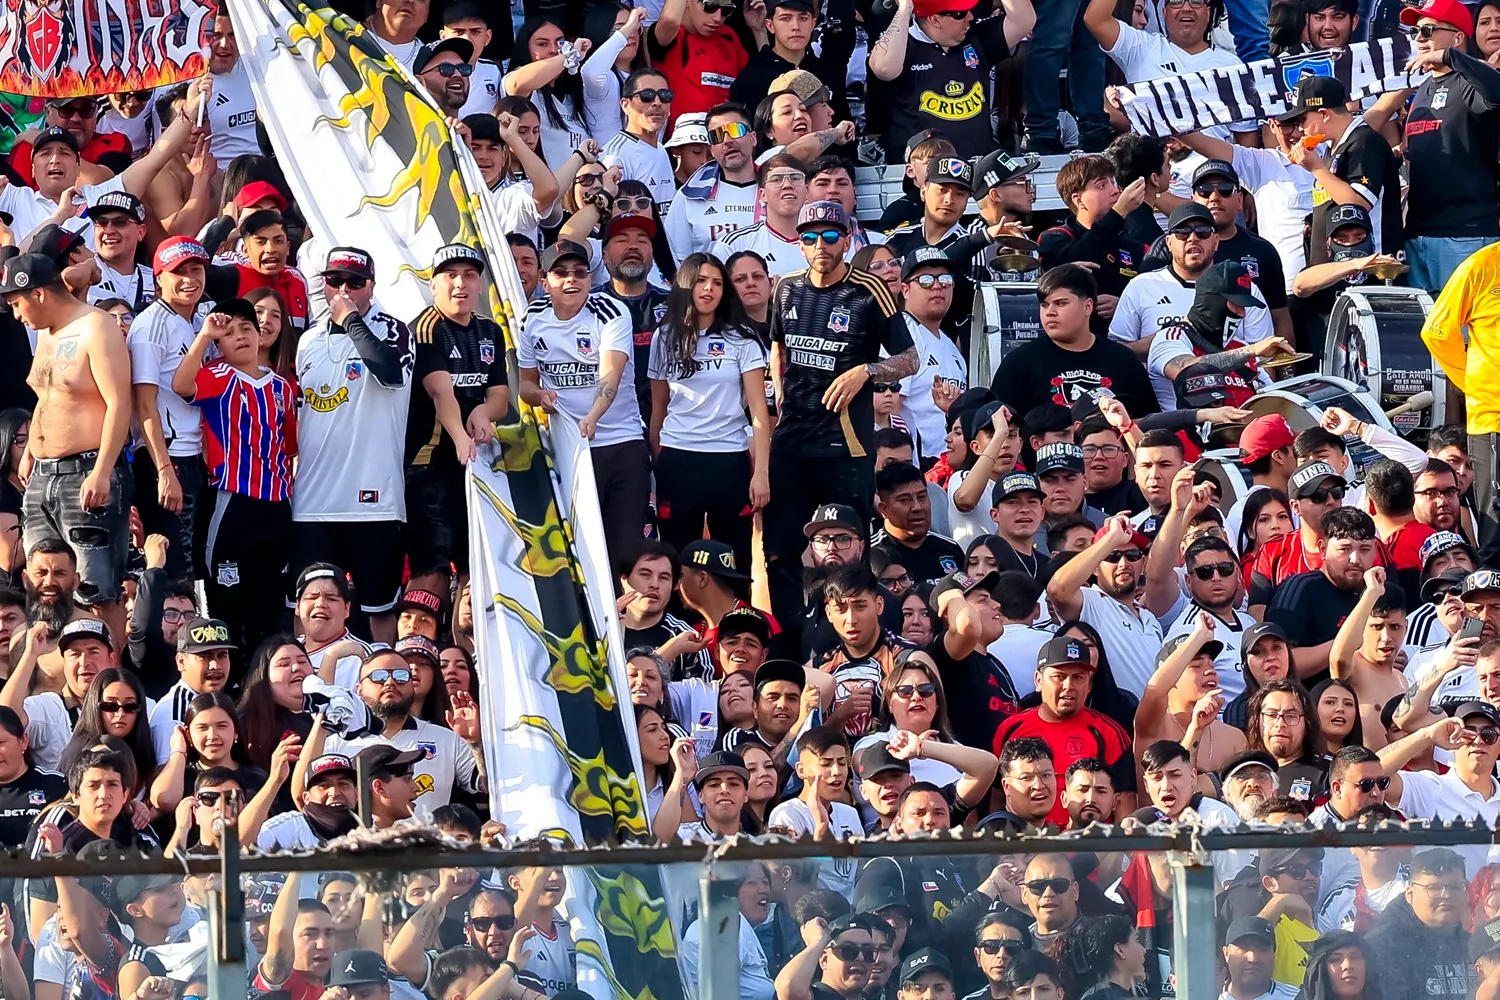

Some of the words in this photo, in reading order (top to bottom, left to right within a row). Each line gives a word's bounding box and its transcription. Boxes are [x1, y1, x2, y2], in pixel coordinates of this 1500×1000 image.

[1121, 57, 1286, 136] MONTE
[1425, 119, 1442, 131] BET
[939, 158, 949, 174] 19
[962, 164, 971, 181] 25
[725, 204, 755, 213] ETERNOS
[805, 205, 815, 222] 19
[826, 205, 841, 222] 25
[791, 336, 821, 351] JUGA
[822, 340, 849, 352] BET
[546, 363, 578, 376] JUGA
[577, 364, 599, 376] BET
[666, 357, 723, 377] DICTV
[1224, 375, 1247, 387] OLBE
[1386, 368, 1408, 381] ESTE
[1408, 369, 1432, 382] AMOR
[824, 506, 838, 521] NY
[910, 955, 929, 968] EA7
